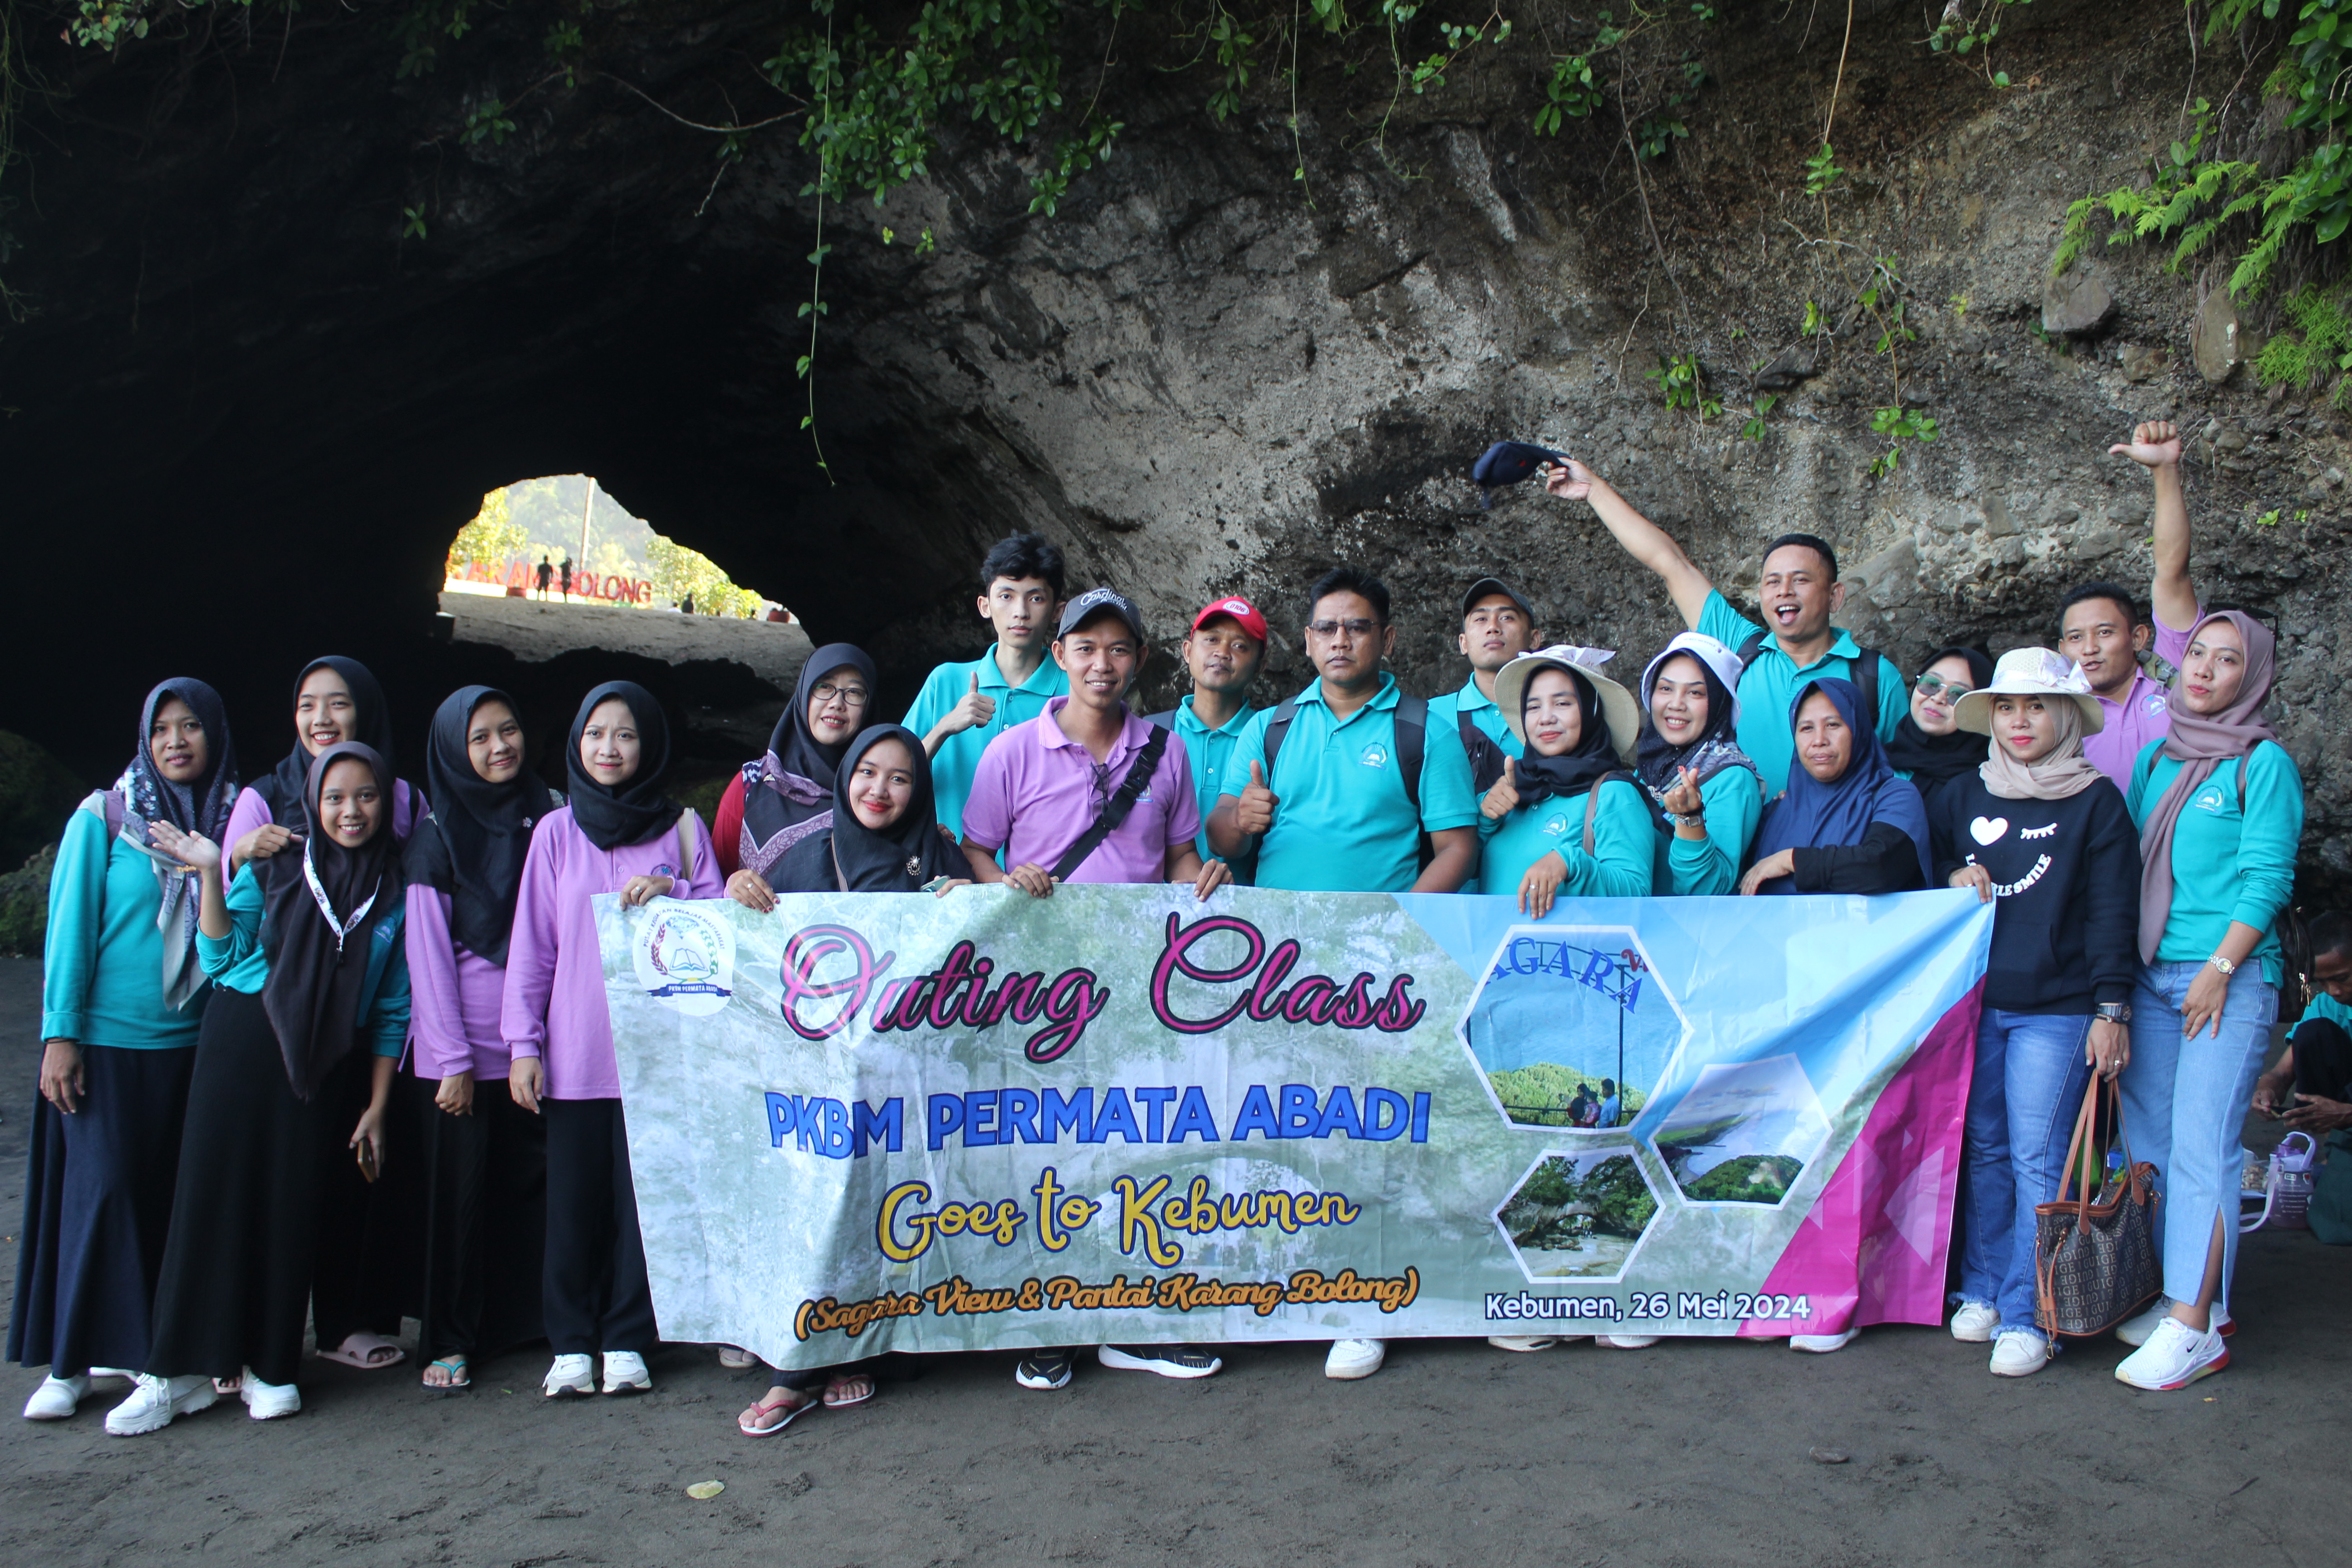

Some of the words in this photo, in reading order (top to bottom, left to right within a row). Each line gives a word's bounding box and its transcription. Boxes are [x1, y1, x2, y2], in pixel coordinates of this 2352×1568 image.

[2013, 853, 2052, 893] SMILE
[643, 927, 654, 948] PUSAT
[651, 908, 672, 927] KEGIATAN
[674, 908, 702, 920] BELAJAR
[702, 918, 725, 949] MASYARAKAT
[780, 924, 1110, 1063] Outing
[1150, 911, 1426, 1034] Class
[764, 1092, 904, 1159] PKBM
[927, 1086, 1220, 1151] PERMATA
[1230, 1084, 1431, 1143] ABADI
[876, 1180, 1028, 1263] Goes
[1031, 1166, 1102, 1252] to
[1112, 1174, 1362, 1268] Kebumen
[794, 1291, 926, 1342] (Sagara
[922, 1275, 1016, 1316] View
[1016, 1277, 1044, 1311] &
[1045, 1274, 1156, 1311] Pantai
[1155, 1273, 1285, 1317] Karang
[1285, 1265, 1421, 1314] Bolong)
[1485, 1290, 1623, 1323] Kebumen,
[1627, 1292, 1671, 1319] 26
[1677, 1289, 1730, 1319] Mei
[1732, 1293, 1812, 1320] 2024
